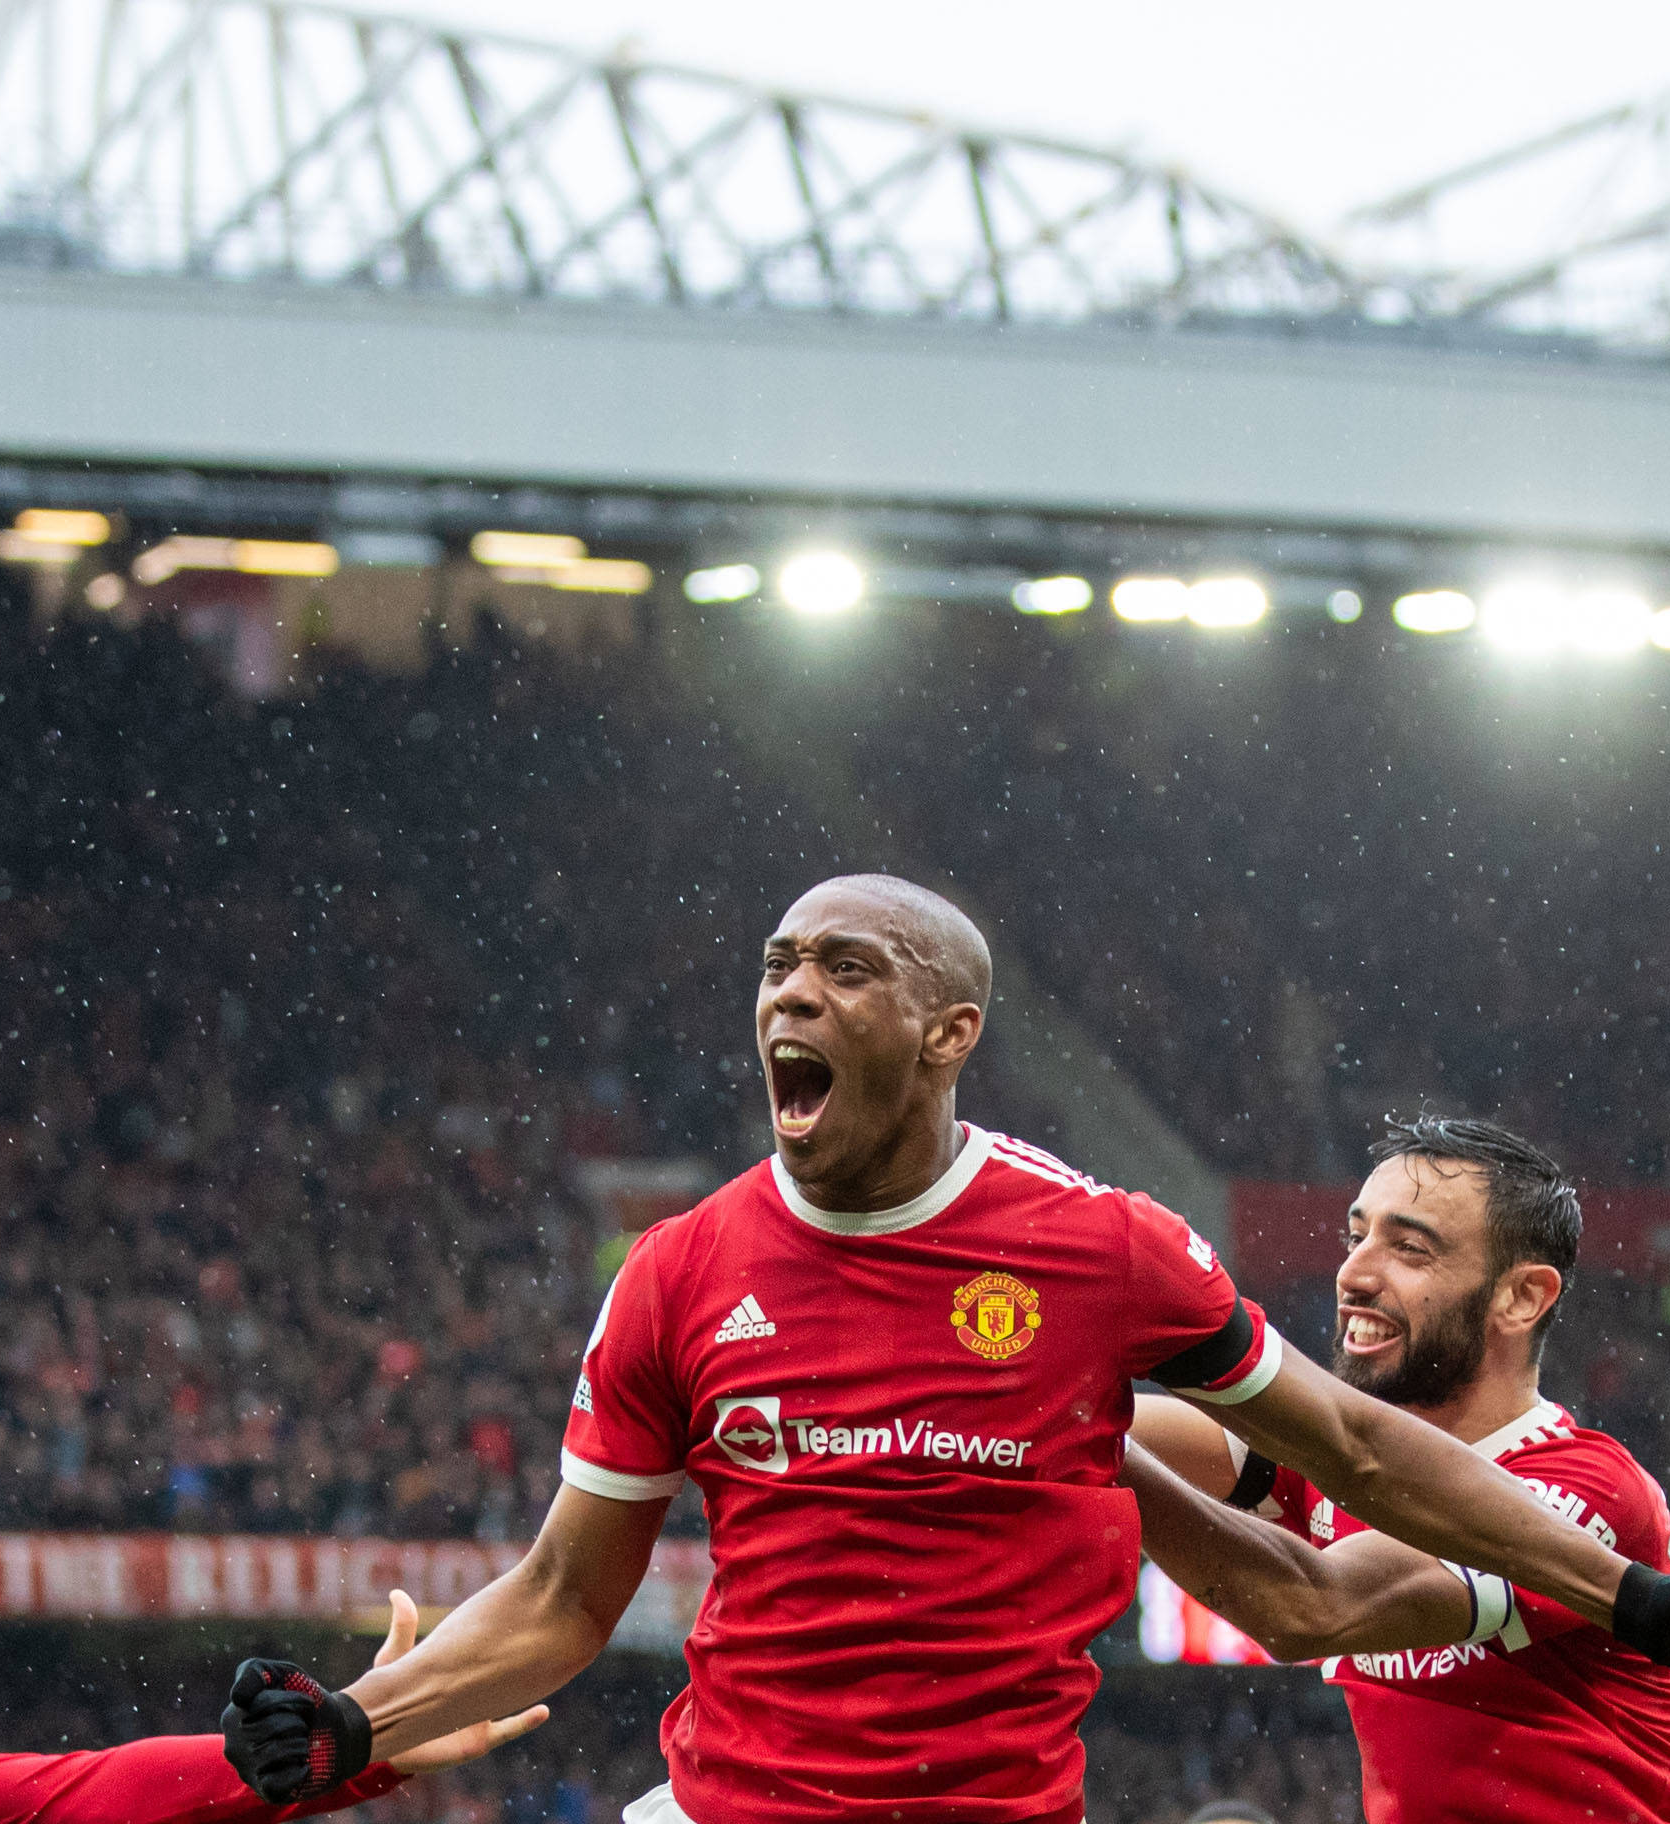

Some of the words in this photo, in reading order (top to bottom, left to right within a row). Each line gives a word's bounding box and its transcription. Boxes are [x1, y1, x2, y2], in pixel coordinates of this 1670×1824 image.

[960, 1277, 1033, 1308] MANCHESTER
[715, 1320, 777, 1344] adidas
[970, 1338, 1022, 1354] UNITED
[786, 1418, 1033, 1468] TeamViewer
[1515, 1476, 1618, 1551] OHLER
